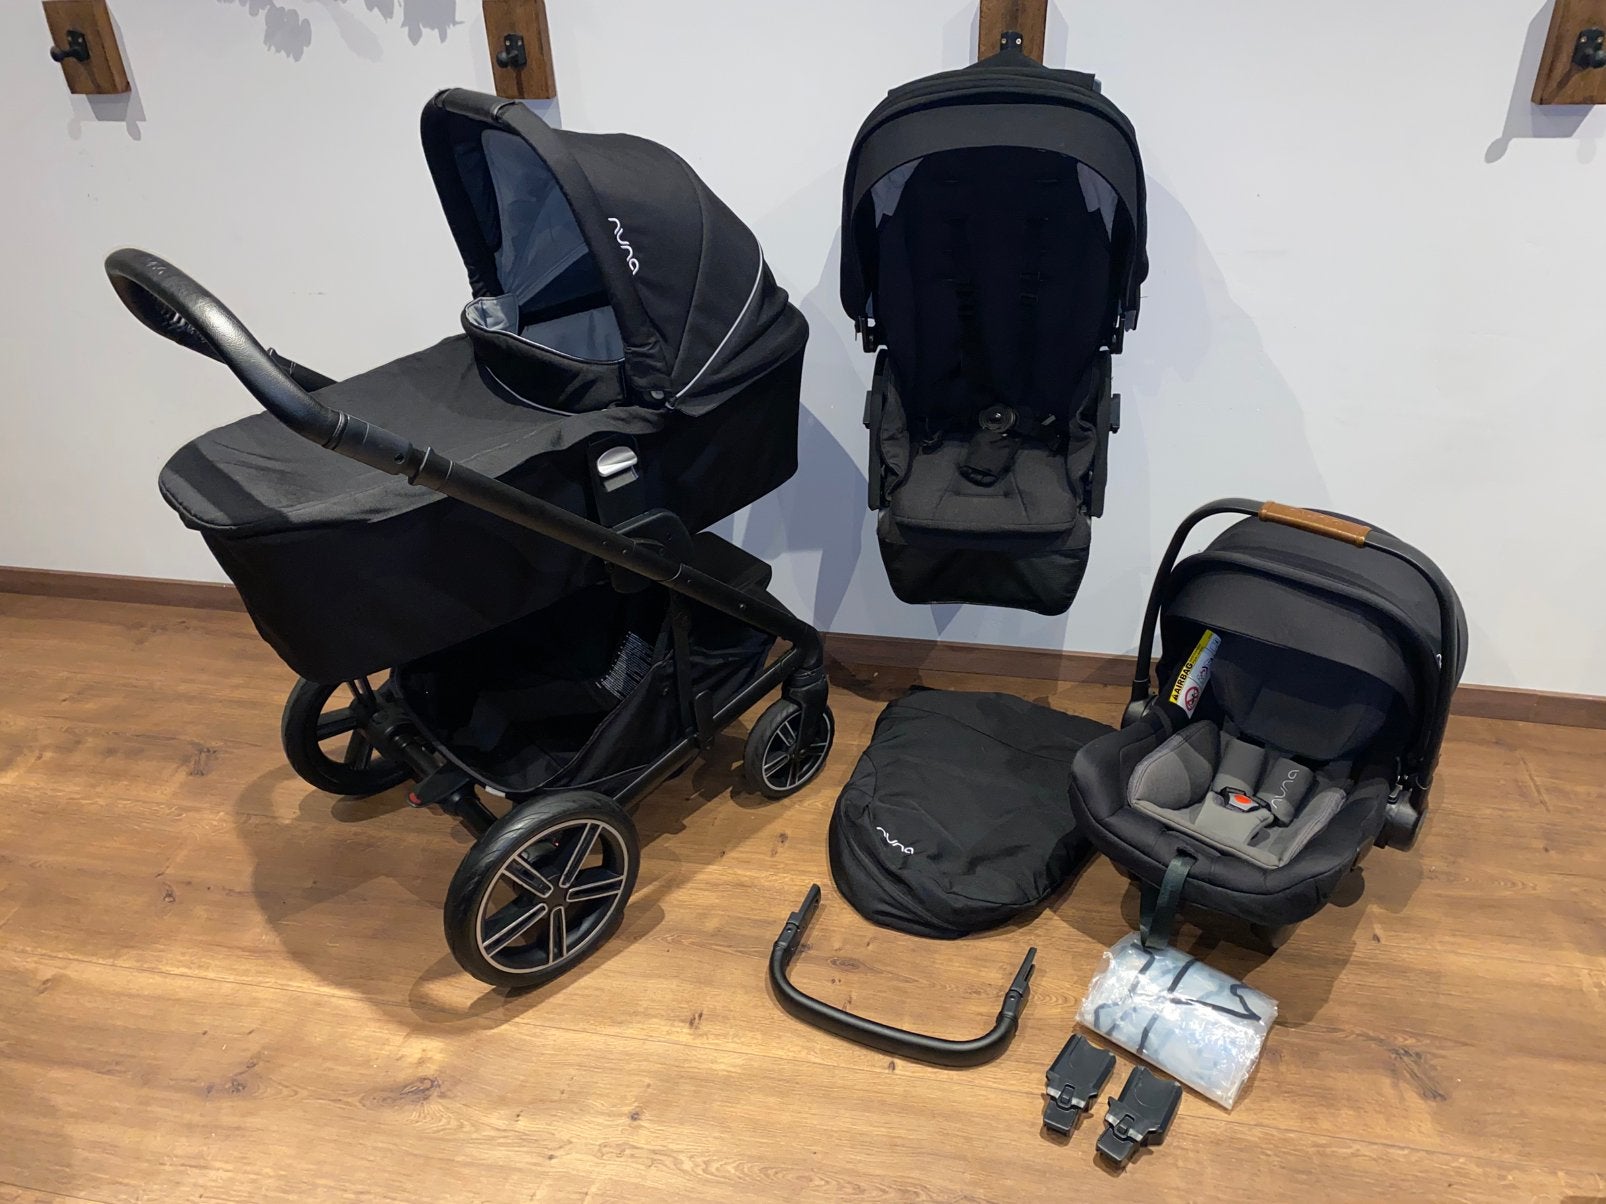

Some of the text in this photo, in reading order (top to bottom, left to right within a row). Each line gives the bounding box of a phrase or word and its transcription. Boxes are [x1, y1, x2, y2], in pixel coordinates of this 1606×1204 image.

[607, 217, 640, 276] nuna
[1174, 662, 1193, 696] AIRBAG
[1271, 769, 1300, 809] nuna
[876, 826, 914, 855] nuna
